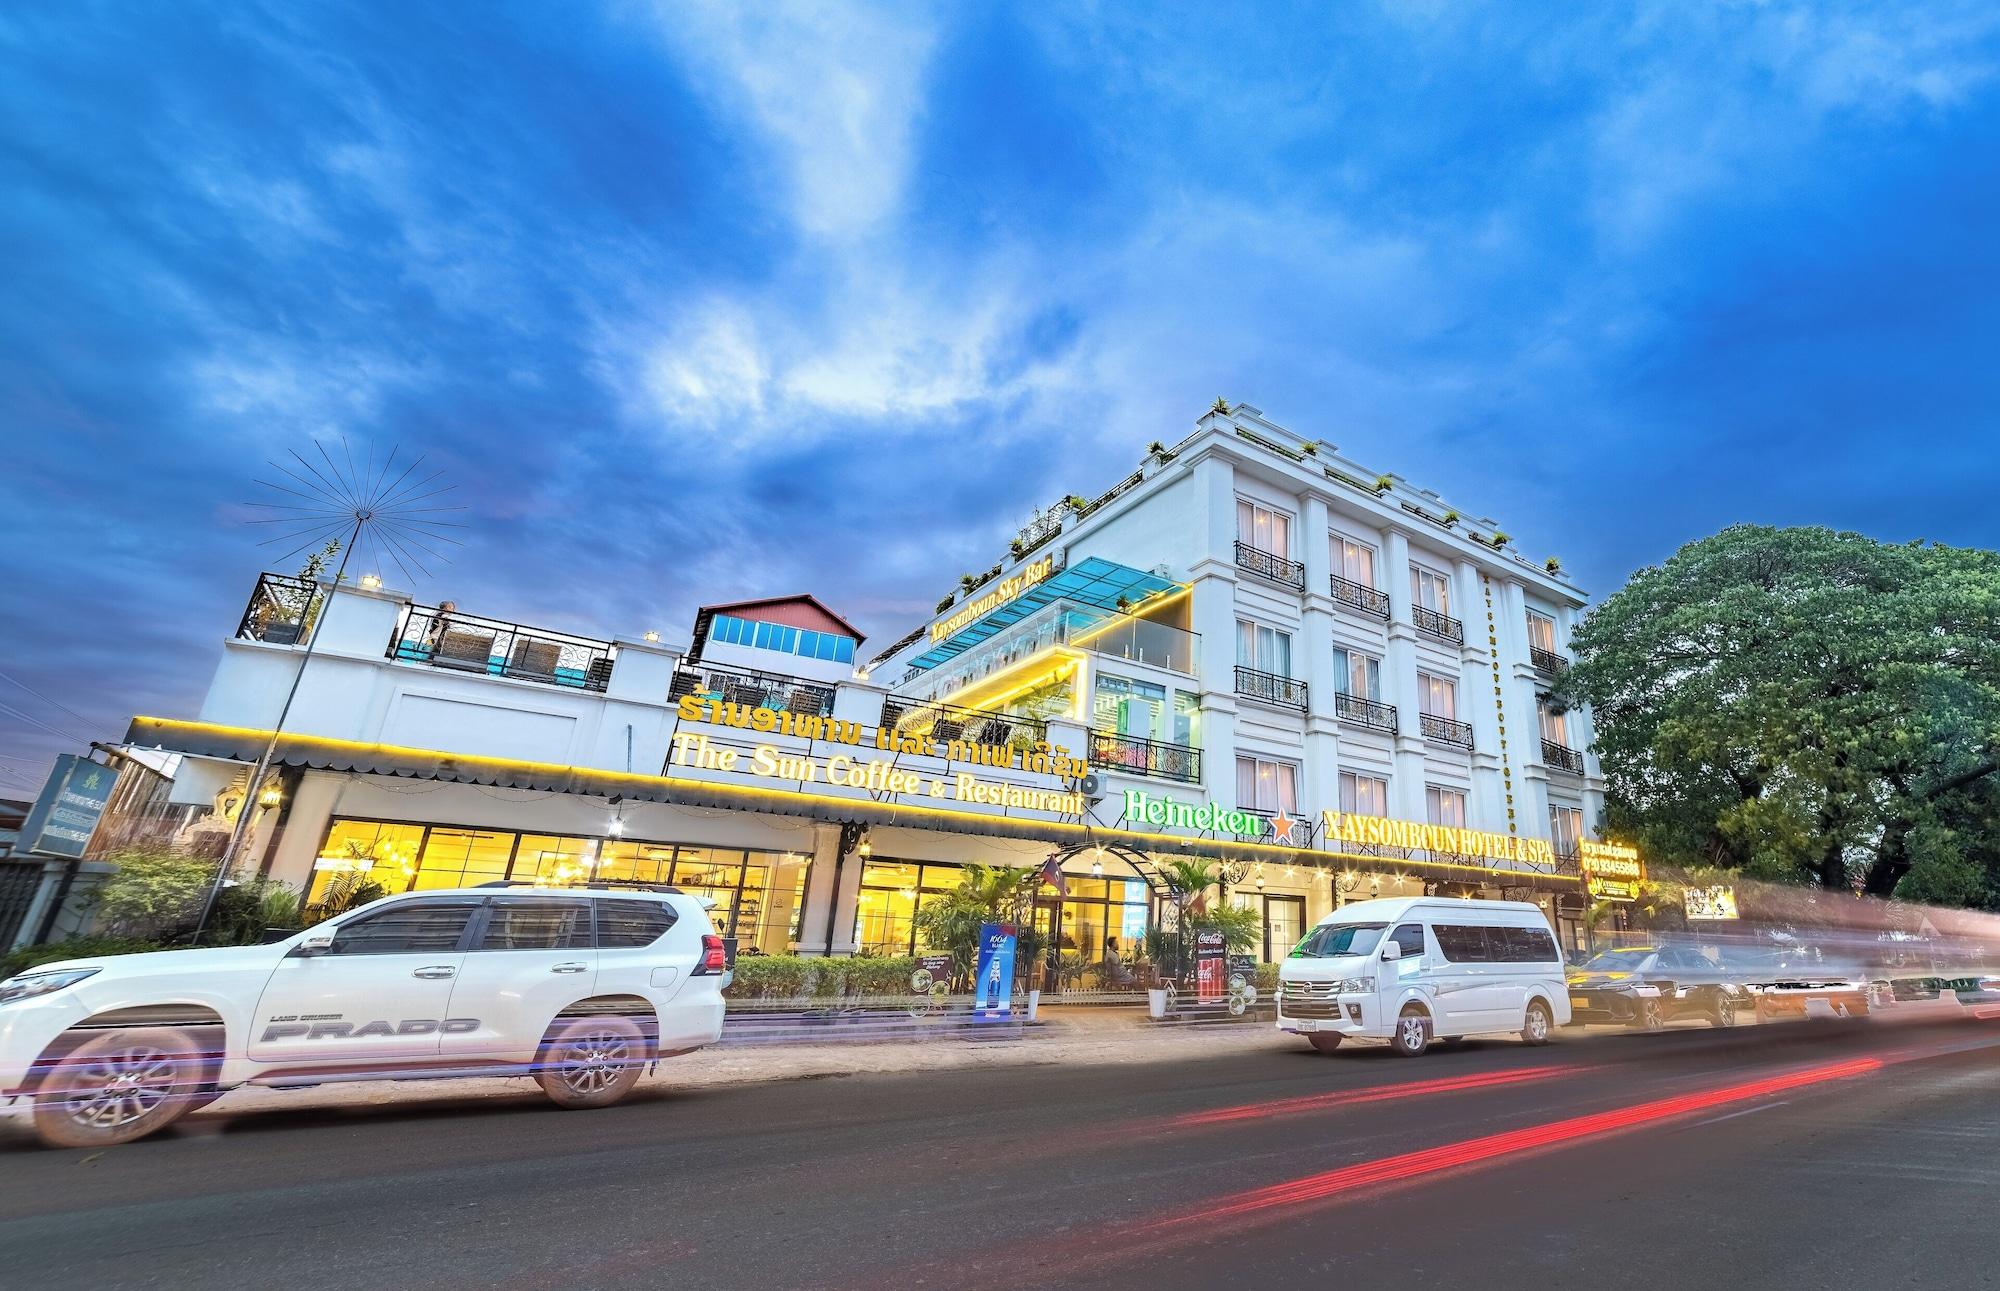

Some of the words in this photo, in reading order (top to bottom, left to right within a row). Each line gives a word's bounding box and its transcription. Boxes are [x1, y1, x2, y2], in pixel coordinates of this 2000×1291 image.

[931, 592, 997, 643] Xaysomboun
[997, 576, 1022, 602] Sky
[1024, 558, 1052, 585] Bar
[673, 733, 738, 771] The
[750, 743, 816, 783] Sun
[825, 754, 921, 796] Coffee
[929, 780, 946, 798] &
[955, 773, 1084, 816] Restaurant
[1123, 789, 1261, 836] Heineken
[1324, 810, 1458, 854] XAYSOMBOUN
[1459, 828, 1515, 860] HOTEL
[1515, 838, 1529, 862] &
[1528, 839, 1555, 865] SPA
[260, 1018, 481, 1042] PRADO
